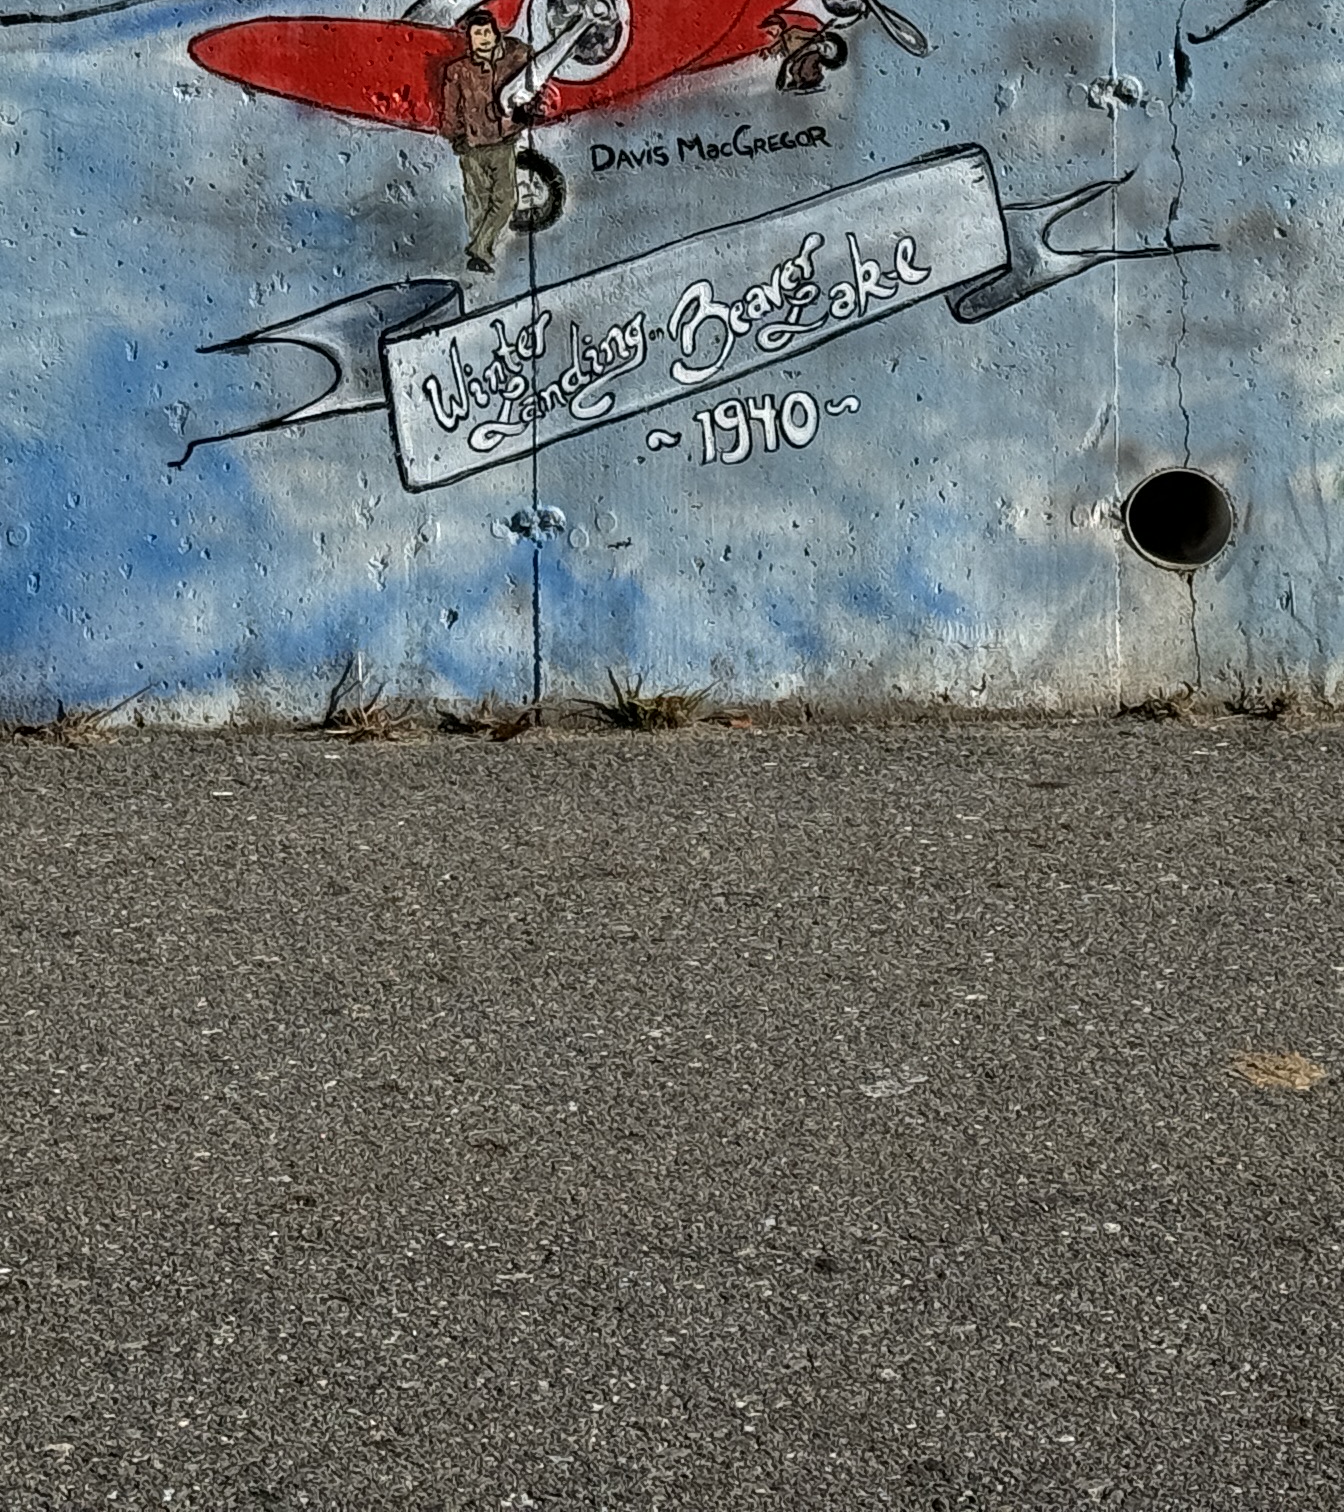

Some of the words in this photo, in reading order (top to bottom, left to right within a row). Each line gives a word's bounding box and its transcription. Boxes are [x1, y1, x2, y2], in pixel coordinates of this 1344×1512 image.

[667, 231, 825, 385] Beaver
[755, 231, 933, 353] Lake
[425, 309, 552, 432] Winter
[468, 310, 648, 453] Landing
